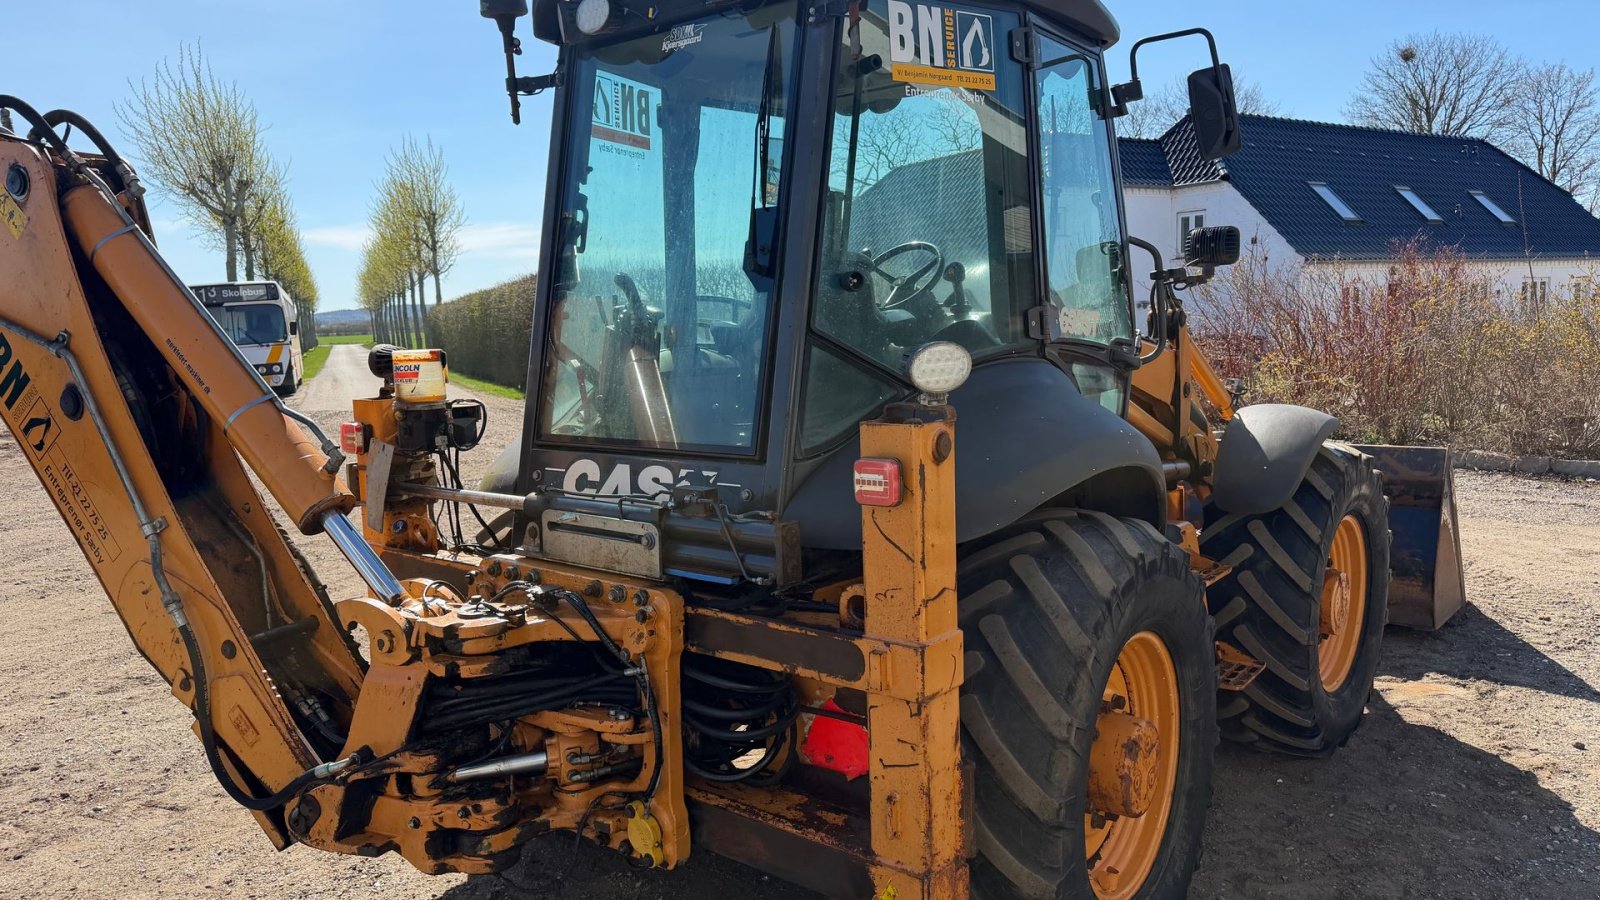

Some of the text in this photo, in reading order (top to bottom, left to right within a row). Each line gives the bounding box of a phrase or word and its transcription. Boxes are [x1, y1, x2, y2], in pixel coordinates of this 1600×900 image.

[887, 0, 944, 67] BN
[904, 70, 929, 79] Benjamin
[221, 288, 264, 298] Skolebus
[44, 464, 105, 564] Entreprenør Sæby
[71, 481, 82, 497] 21
[79, 496, 91, 511] 22
[89, 511, 100, 526] 75
[97, 525, 109, 541] 25
